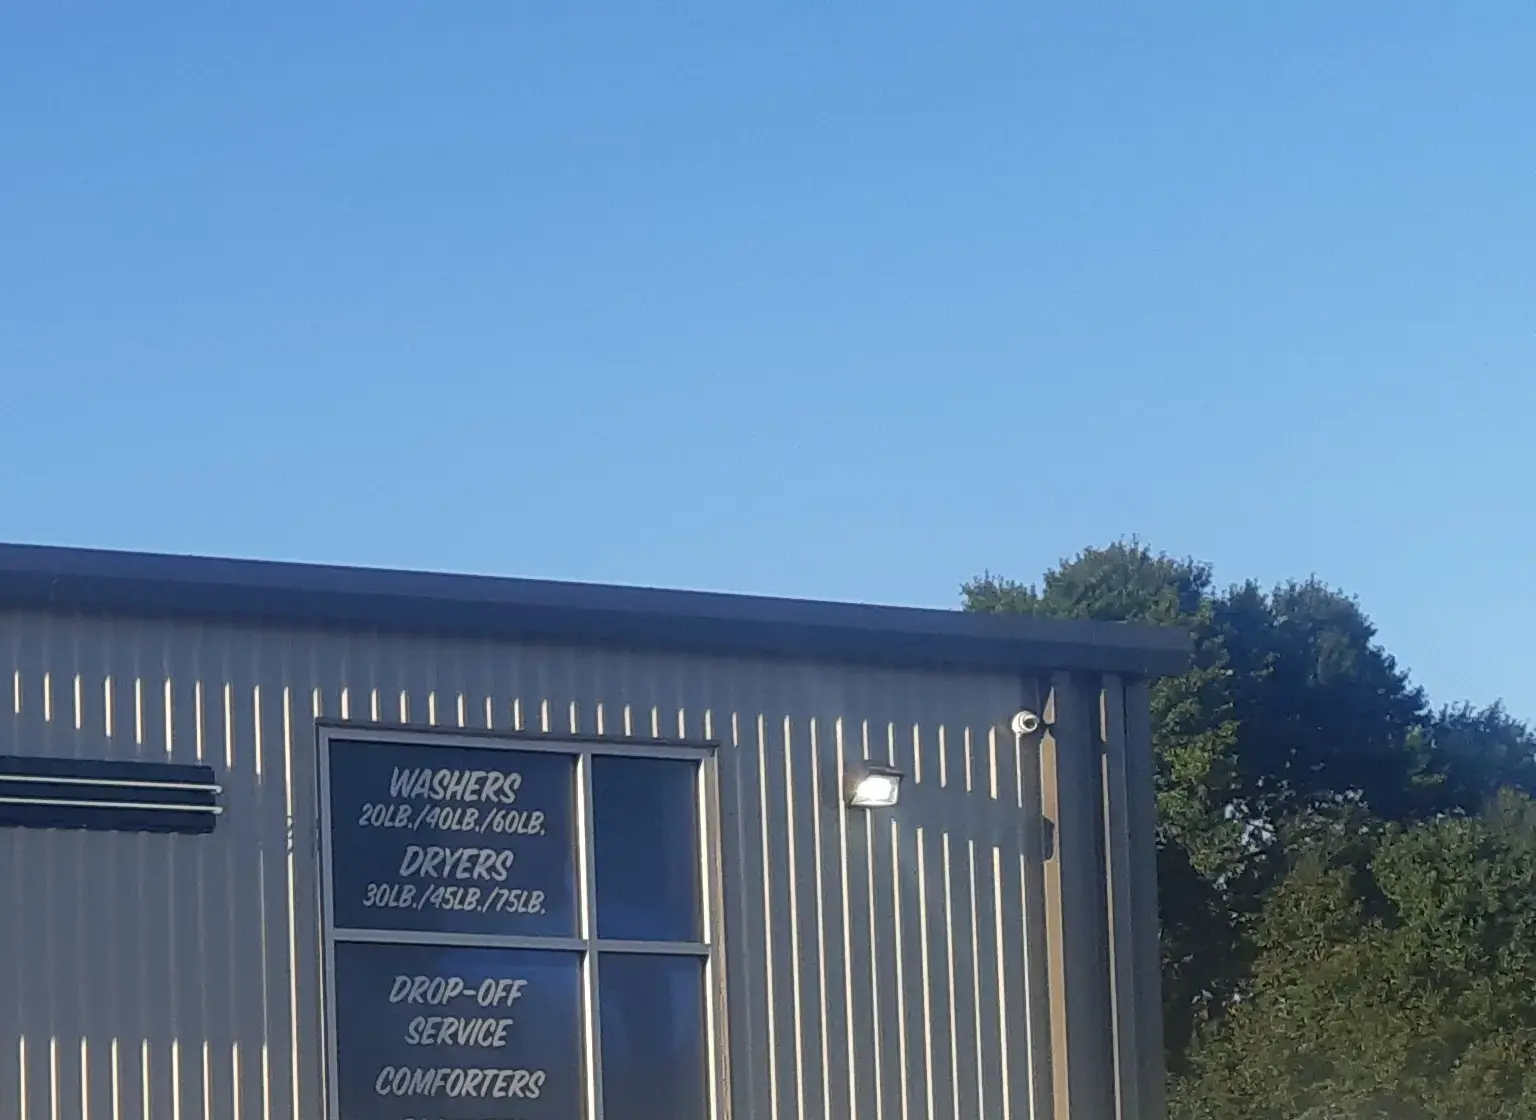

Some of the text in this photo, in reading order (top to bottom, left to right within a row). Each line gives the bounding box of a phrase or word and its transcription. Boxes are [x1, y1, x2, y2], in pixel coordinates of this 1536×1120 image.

[389, 766, 522, 804] WASHERS
[399, 845, 514, 882] DRYERS
[388, 975, 528, 1008] DROP-OFF
[404, 1015, 514, 1048] SERVICE
[375, 1065, 546, 1099] COMFORTERS
